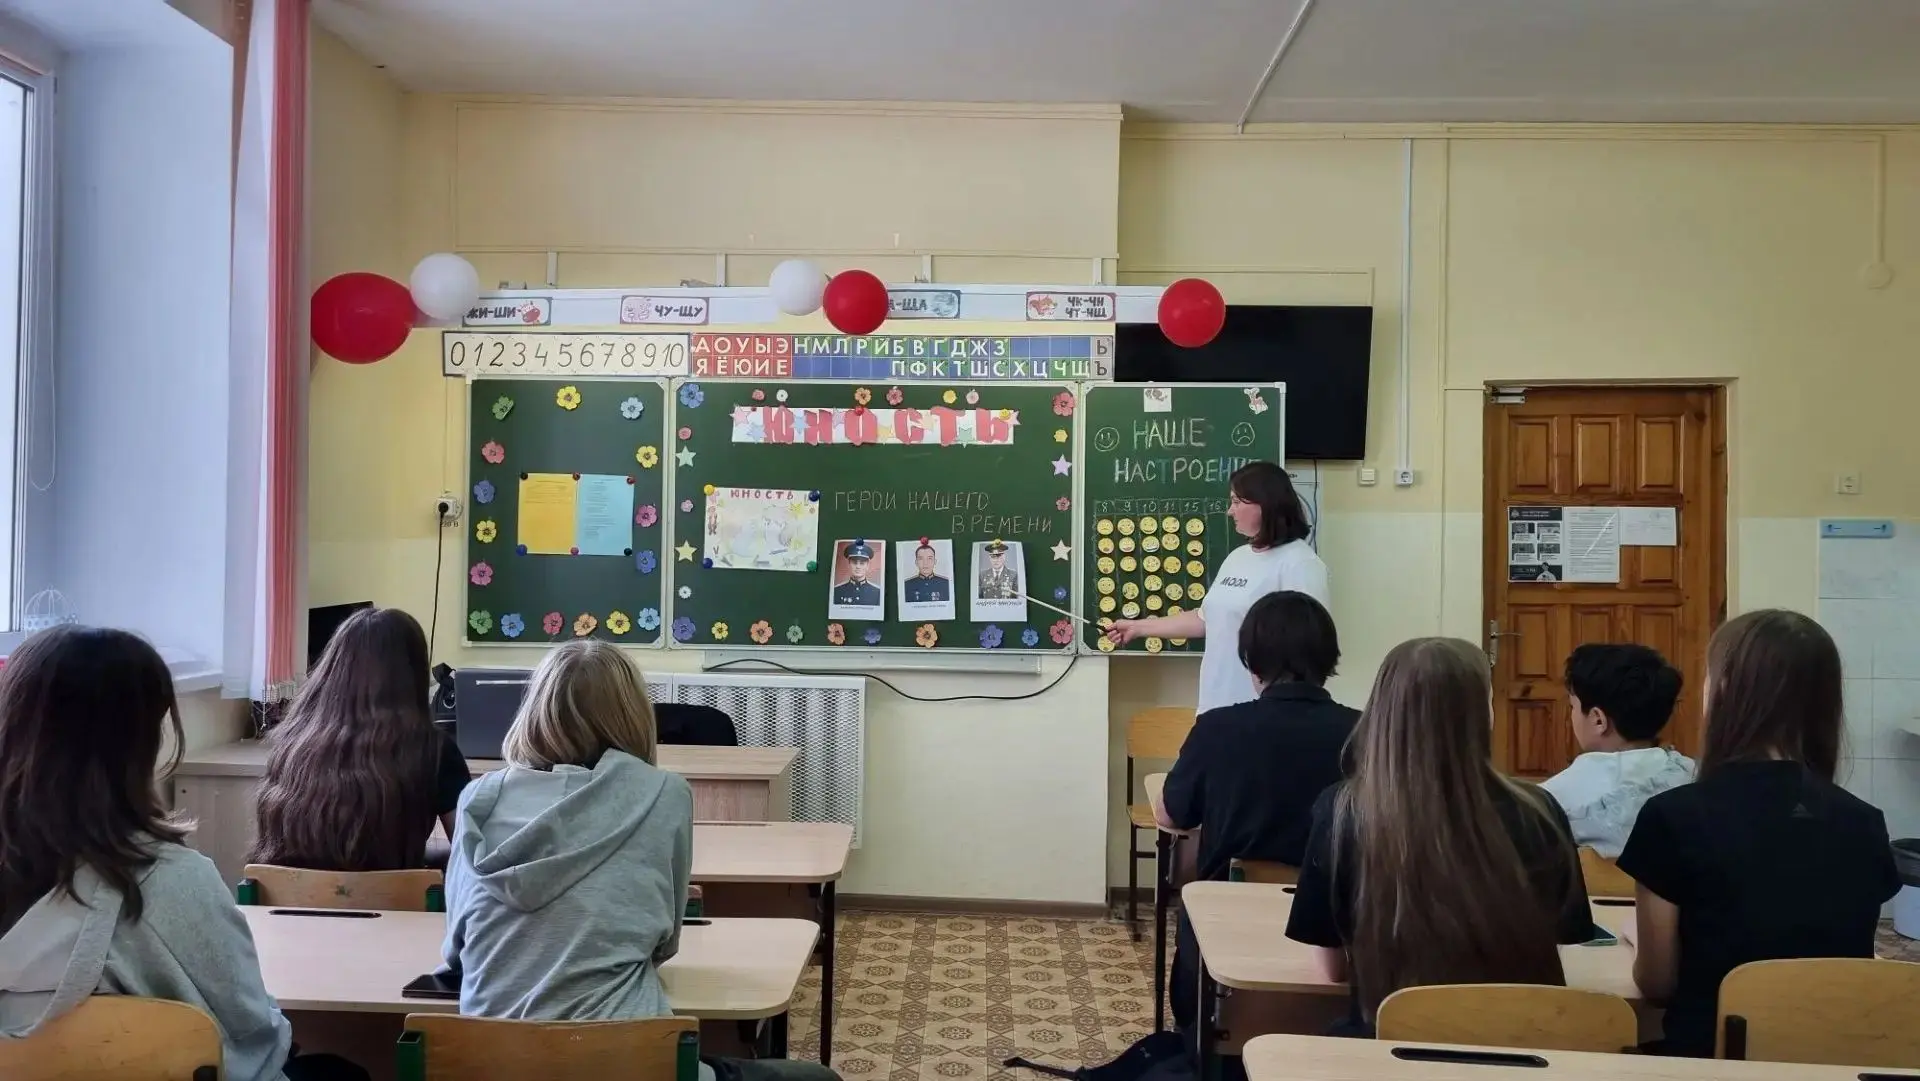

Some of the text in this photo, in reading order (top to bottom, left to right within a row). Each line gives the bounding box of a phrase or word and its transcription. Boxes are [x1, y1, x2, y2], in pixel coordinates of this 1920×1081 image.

[654, 306, 703, 318] ЧУ-ЩУ
[888, 297, 927, 311] А-ЩА
[763, 405, 1010, 447] ЮНОСТЬ
[1133, 418, 1208, 449] НАШЕ
[1114, 457, 1262, 483] НАСТРОЕН
[730, 489, 794, 501] ЮНОСТЬ
[834, 490, 990, 512] ГЕРОИ НАШЕГО
[1101, 501, 1108, 512] 8
[1143, 501, 1157, 512] 10
[1184, 501, 1200, 512] 15
[951, 514, 1051, 534] ВРЕМЕНИ
